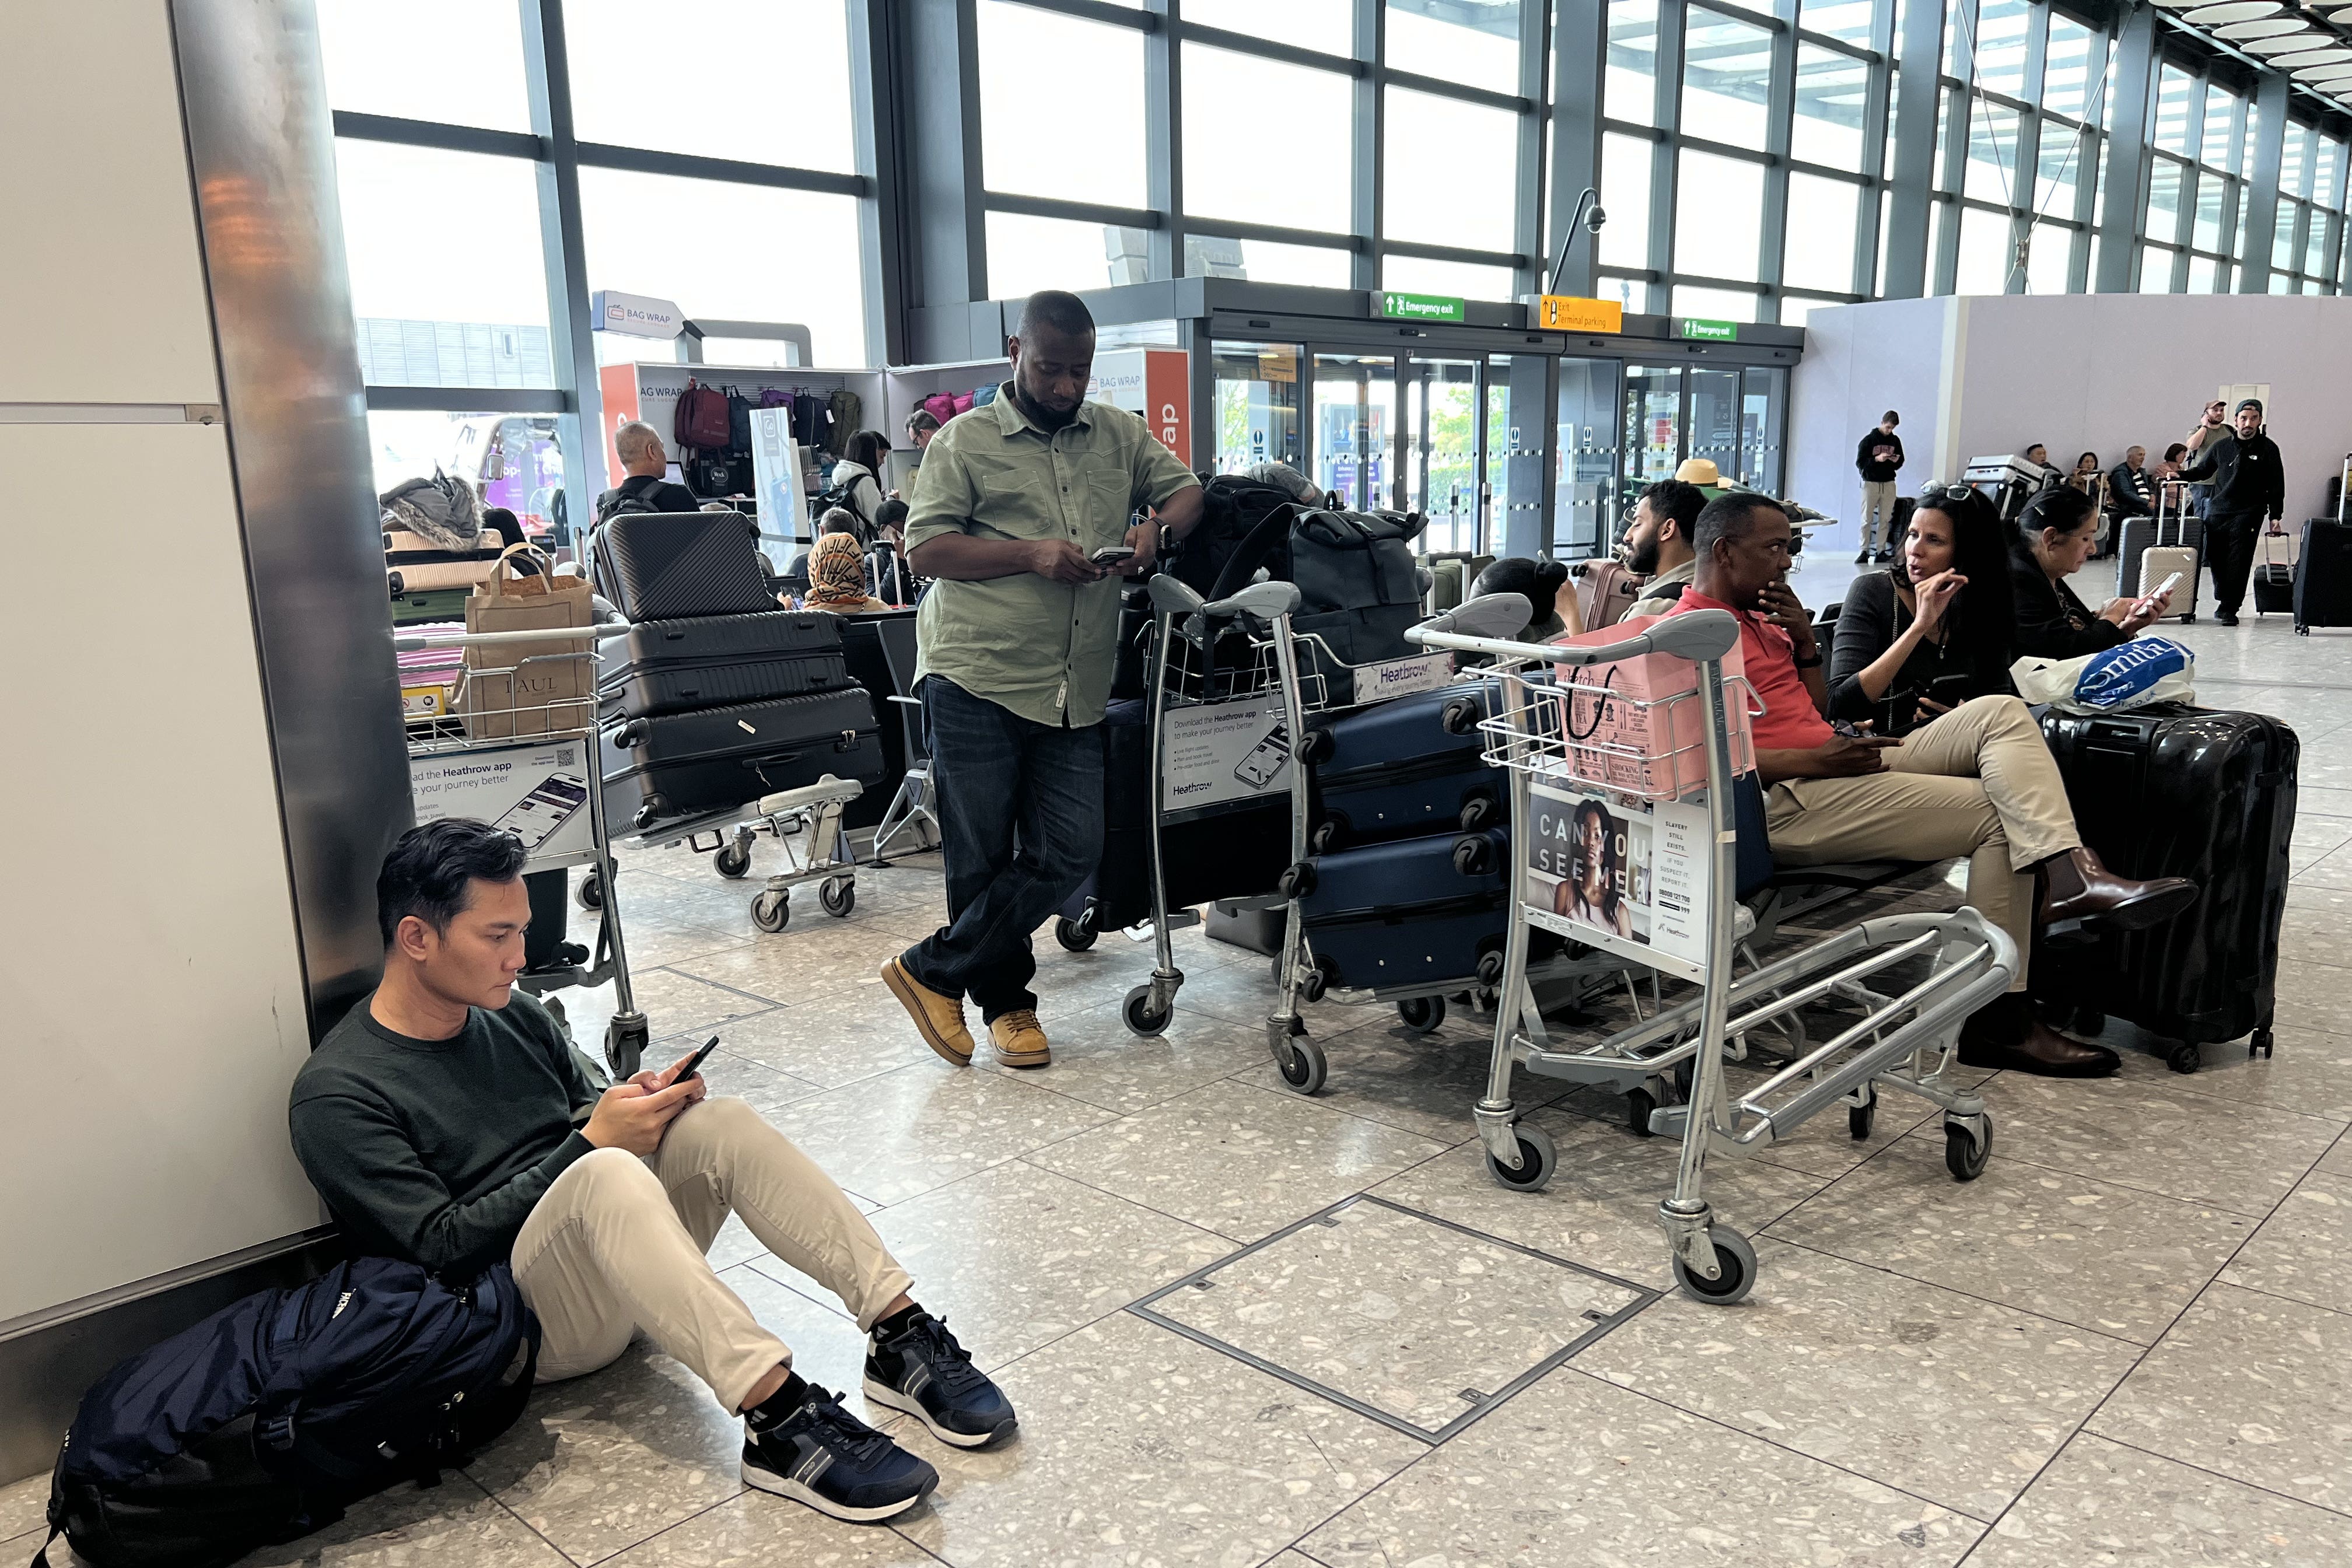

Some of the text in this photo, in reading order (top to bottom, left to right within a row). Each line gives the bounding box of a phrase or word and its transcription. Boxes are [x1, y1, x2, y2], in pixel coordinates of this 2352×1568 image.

[1406, 302, 1454, 316] Emergency exit
[1558, 302, 1570, 312] Exit
[627, 309, 670, 323] BAG WRAP
[1558, 314, 1606, 329] Terminal parking
[1697, 324, 1721, 337] Emergency
[1100, 376, 1140, 388] BAG WRAP
[640, 387, 682, 397] AG WRAP
[1161, 404, 1180, 456] rap
[1174, 718, 1203, 729] Download
[1214, 712, 1244, 722] Heathrow
[1245, 710, 1256, 719] app
[1576, 713, 1587, 724] TEA
[1182, 730, 1198, 738] make
[1199, 728, 1213, 738] your
[1213, 724, 1236, 736] journey
[1236, 722, 1255, 730] better
[443, 765, 491, 778] Heathrow
[494, 762, 512, 772] app
[1611, 763, 1639, 775] SHOCKING
[421, 785, 442, 796] your
[444, 779, 479, 793] journey
[481, 774, 509, 785] better
[1173, 782, 1212, 796] Heathrow
[416, 803, 439, 812] updates
[1665, 821, 1688, 831] SLAVERY
[1540, 814, 1646, 862] CAN YOU
[1669, 832, 1683, 841] STILL
[1667, 842, 1686, 852] EXISTS.
[1539, 848, 1583, 881] SEE
[1660, 866, 1682, 876] SUSPECT
[1661, 876, 1681, 886] REPORT
[1659, 888, 1673, 898] 08000
[1681, 894, 1690, 903] 700
[1681, 907, 1690, 915] 999
